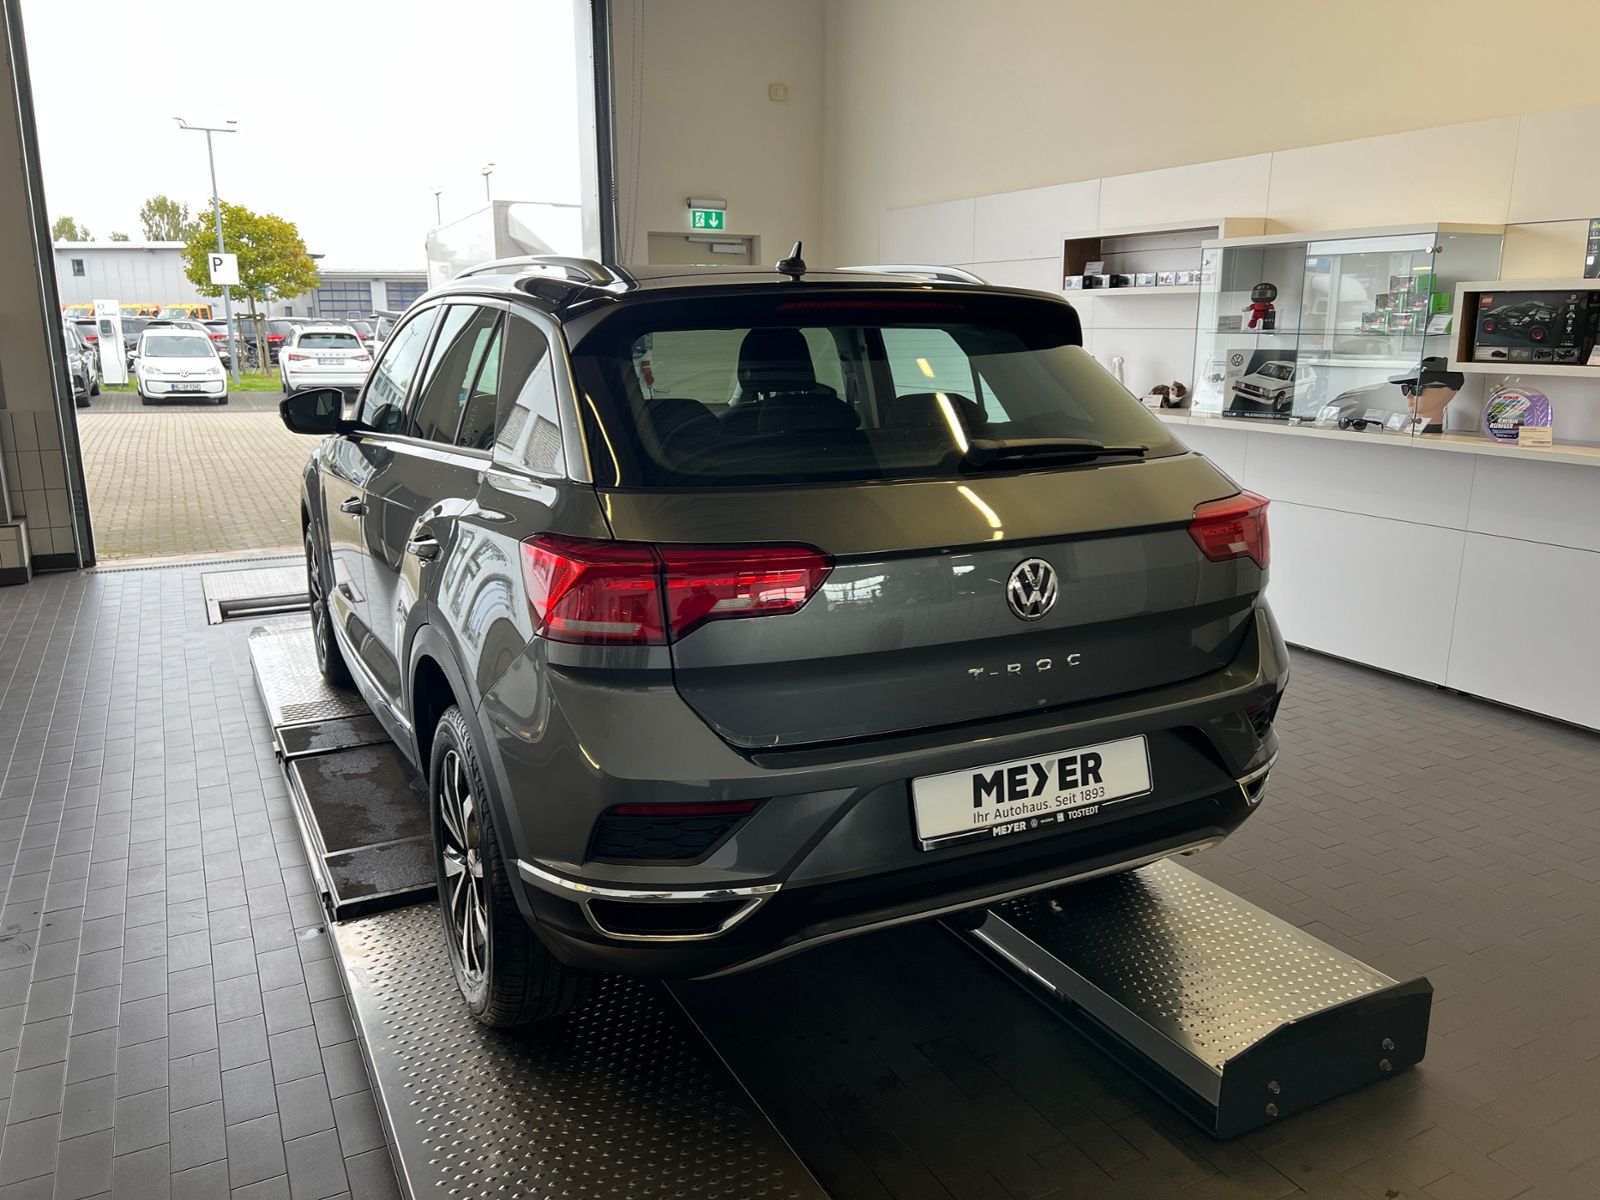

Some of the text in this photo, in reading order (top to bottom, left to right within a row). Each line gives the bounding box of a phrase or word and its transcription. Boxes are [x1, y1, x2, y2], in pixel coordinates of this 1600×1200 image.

[212, 256, 223, 273] P
[968, 653, 1081, 680] T-ROC
[973, 752, 1103, 808] MEYER
[973, 786, 1105, 824] Ihr Autohaus. Seit 1893
[992, 821, 1027, 837] MEYER
[1067, 805, 1100, 820] TOSTEDT
